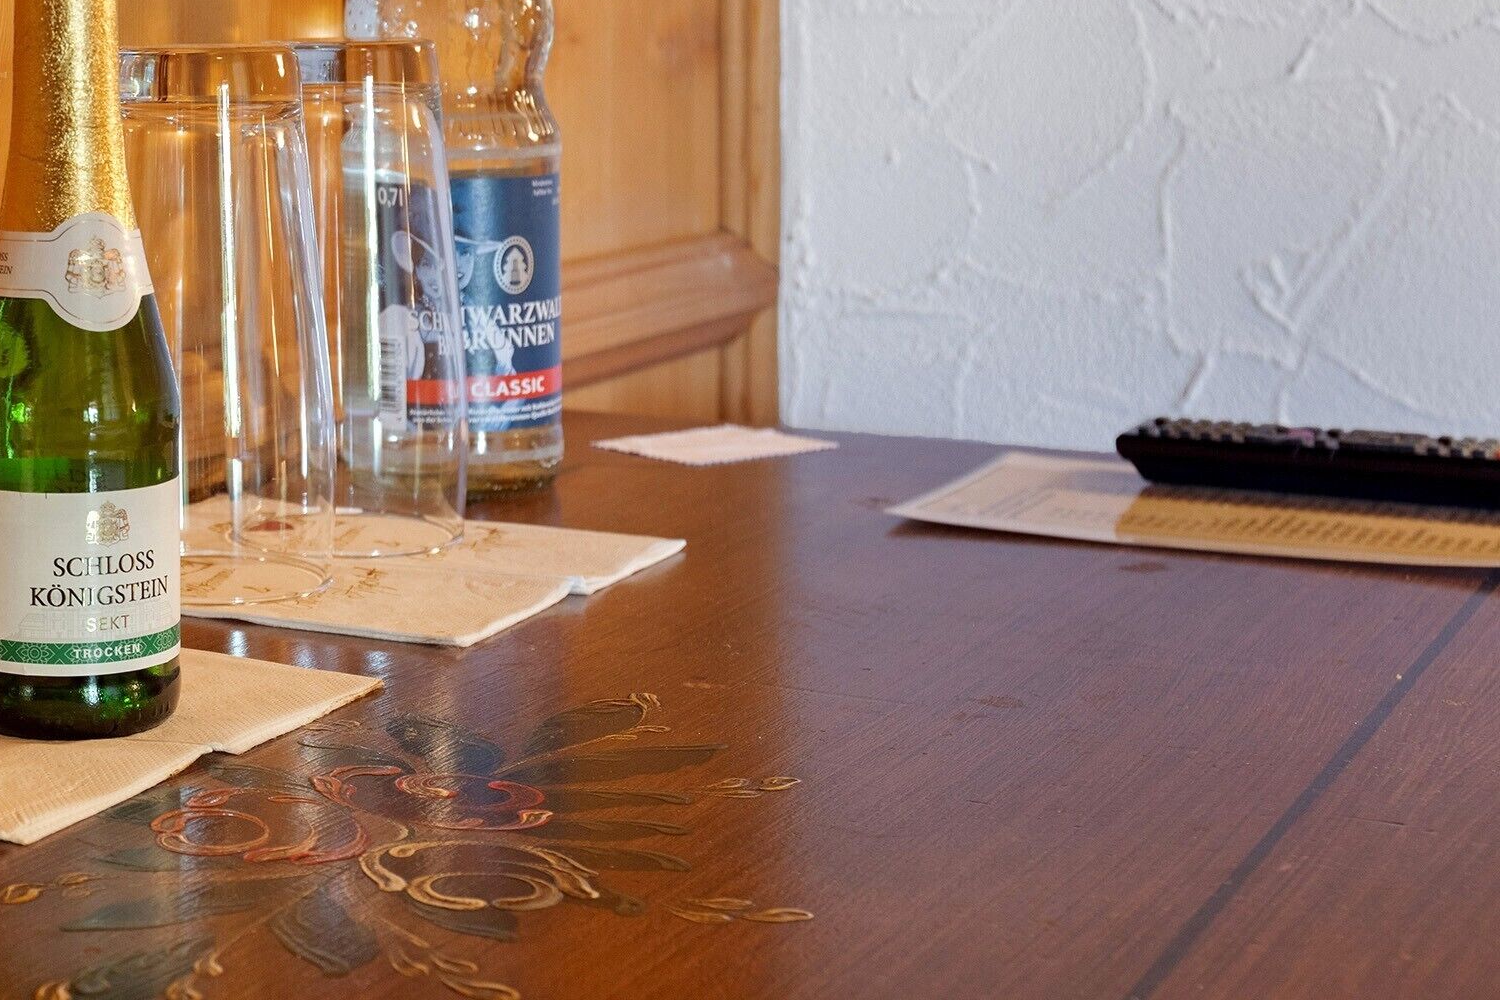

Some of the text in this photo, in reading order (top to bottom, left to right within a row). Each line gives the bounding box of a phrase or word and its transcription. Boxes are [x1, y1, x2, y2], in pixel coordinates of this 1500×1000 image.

[470, 376, 546, 399] CLASSIC
[52, 549, 155, 577] SCHLOSS
[29, 575, 168, 608] KÖNIGSTEIN
[86, 614, 130, 633] SEKT
[73, 643, 142, 660] TROCKEN
